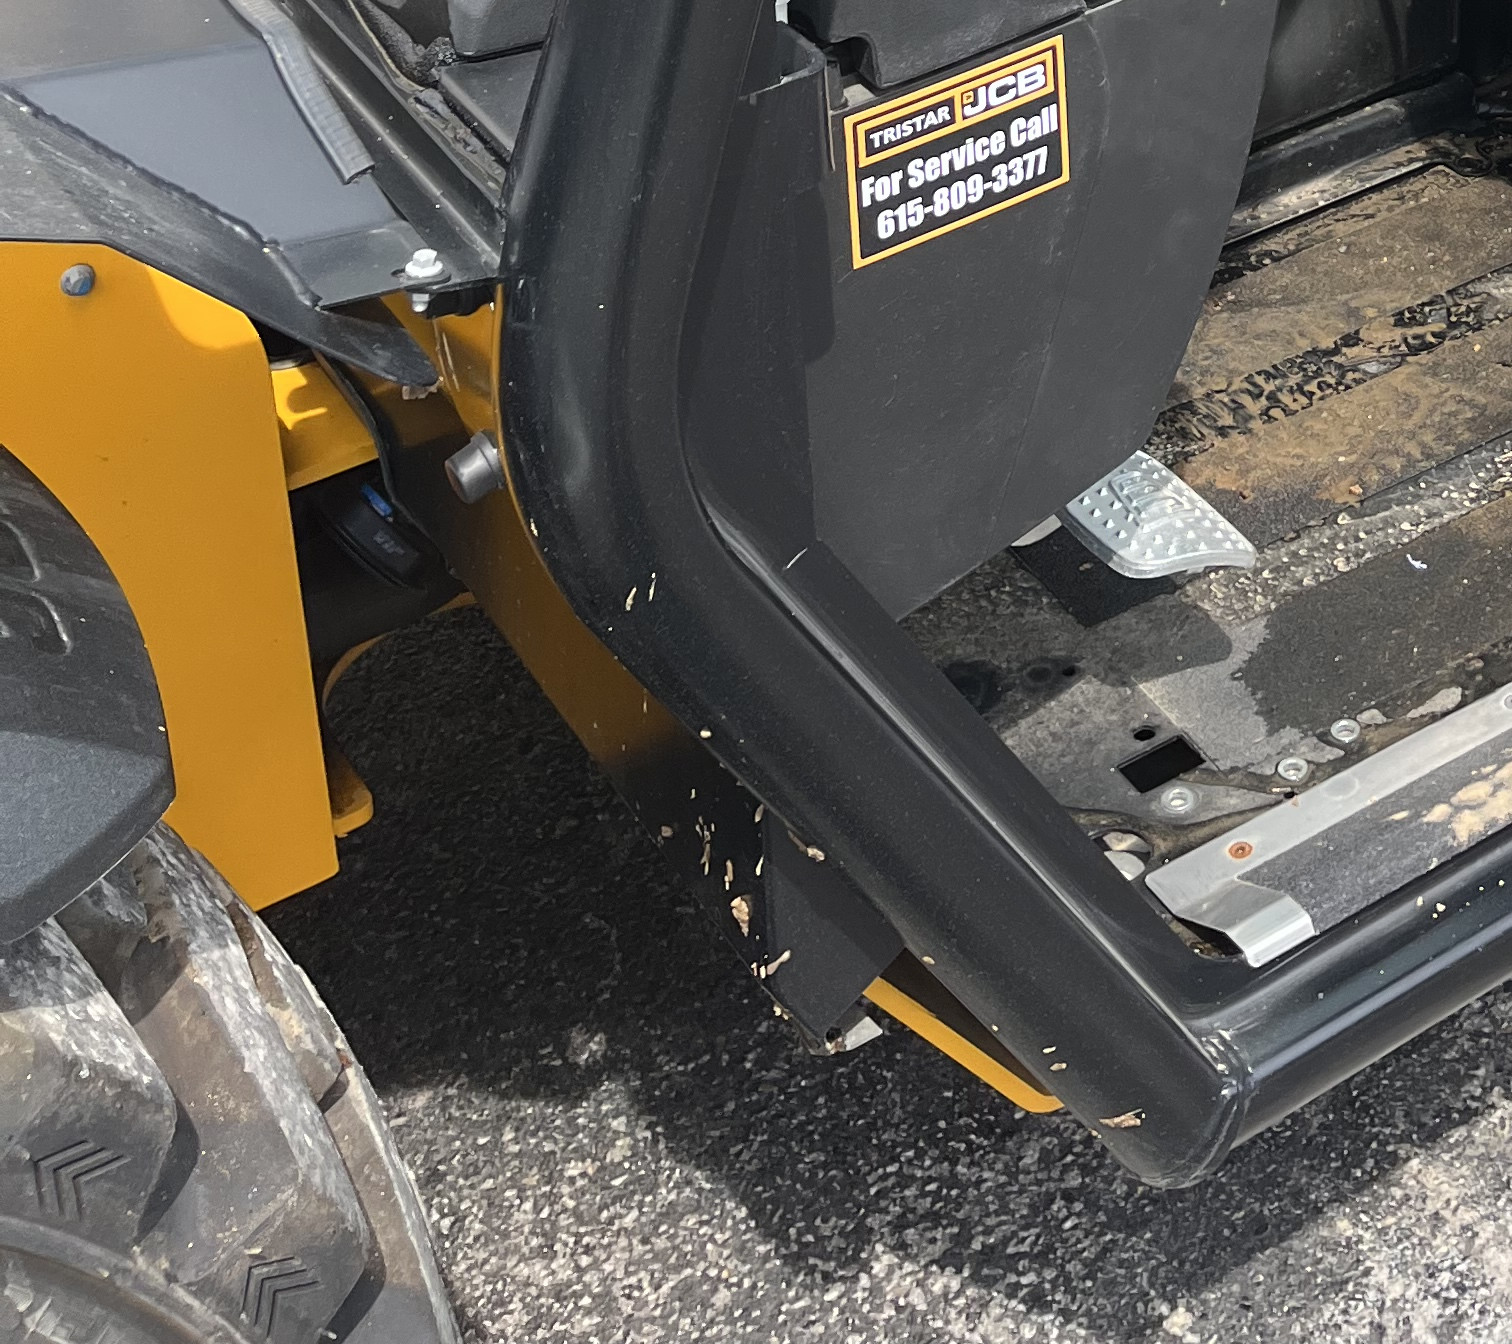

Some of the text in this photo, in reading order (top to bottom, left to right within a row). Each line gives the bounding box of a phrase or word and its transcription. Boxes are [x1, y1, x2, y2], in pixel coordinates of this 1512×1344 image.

[869, 63, 1046, 148] TRISTAR JCB
[861, 103, 1059, 208] For Service Call
[877, 145, 1049, 240] 615-809-3377
